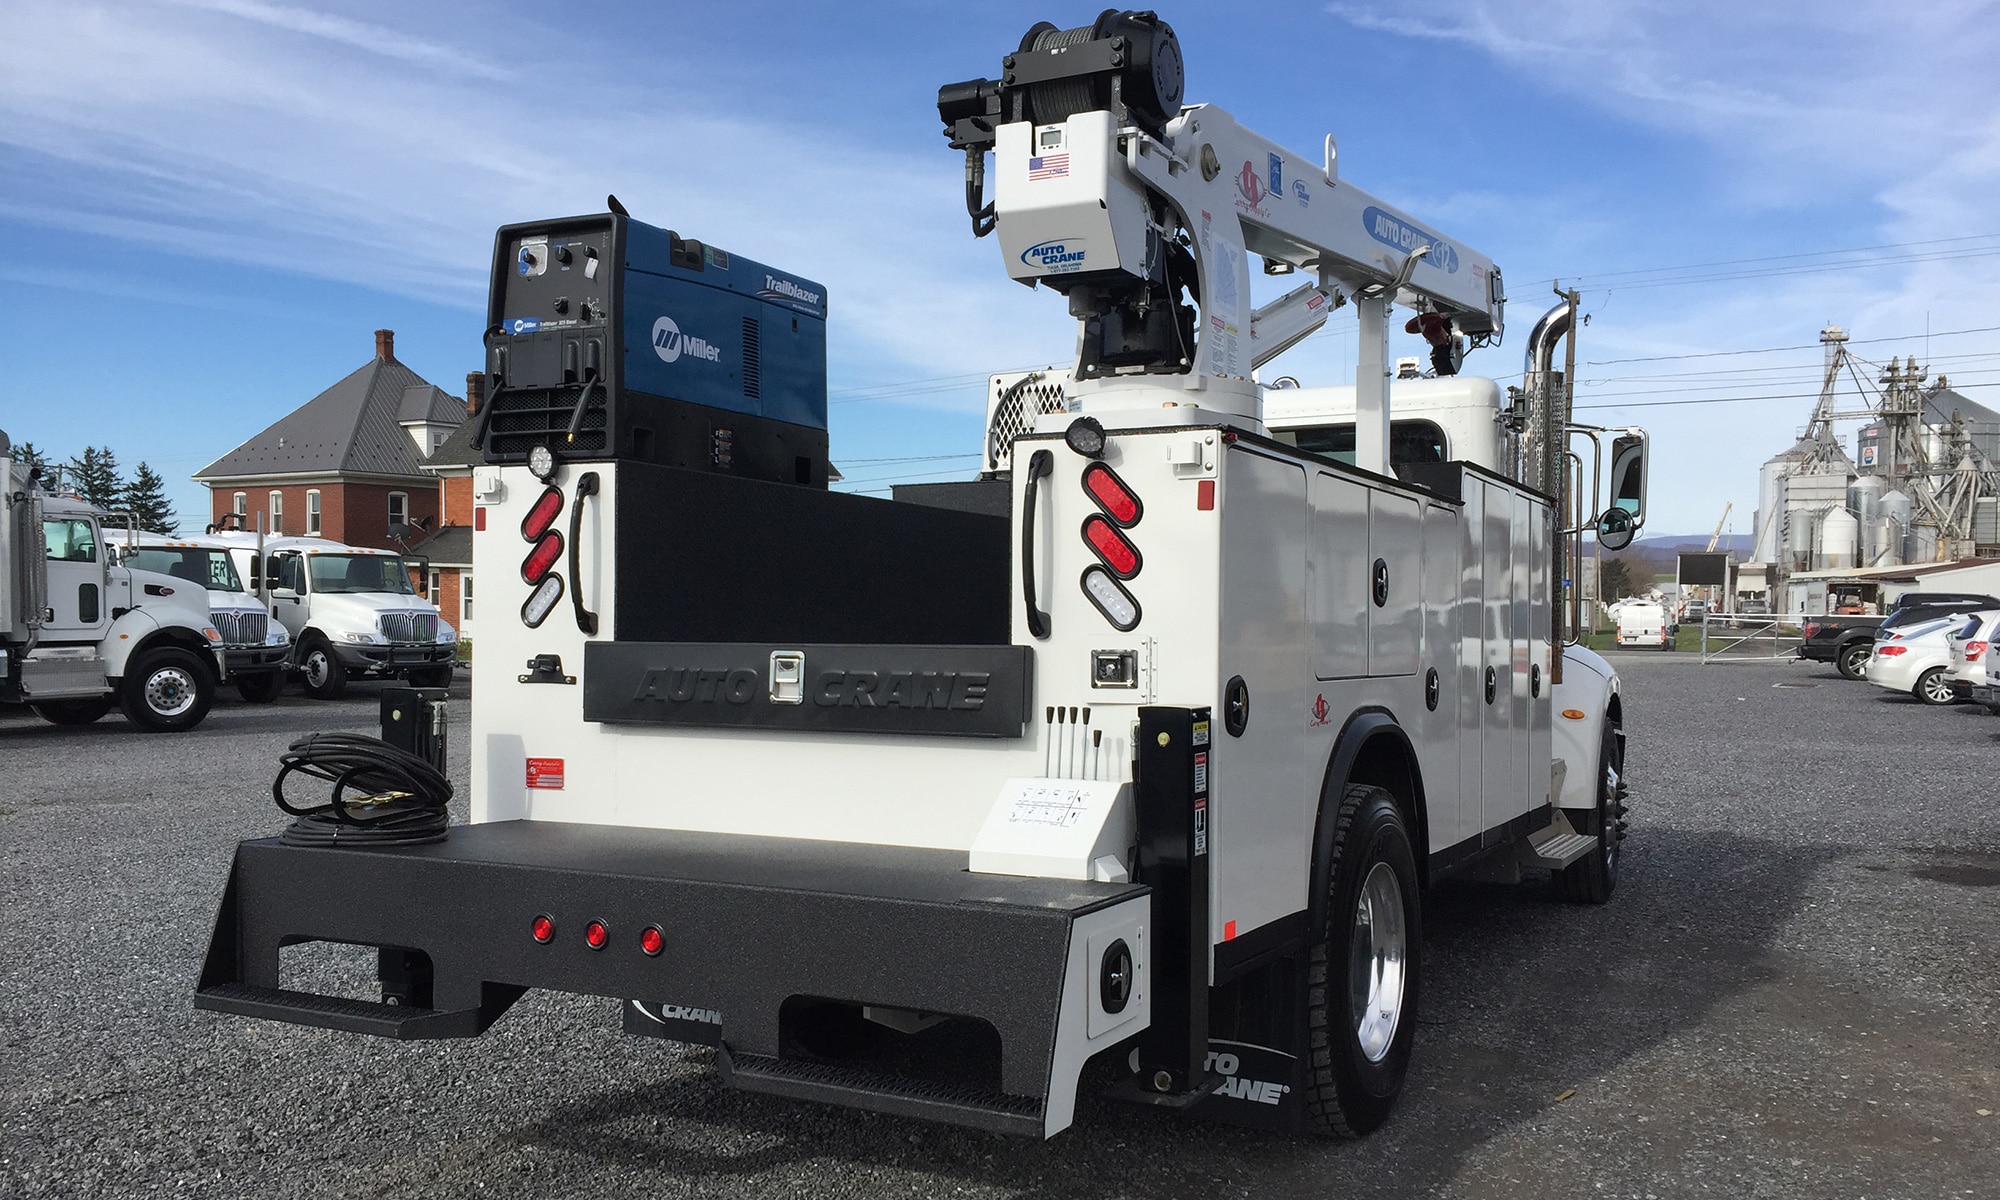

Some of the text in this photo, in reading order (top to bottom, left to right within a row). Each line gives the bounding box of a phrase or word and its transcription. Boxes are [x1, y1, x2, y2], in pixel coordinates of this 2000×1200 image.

[1375, 215, 1399, 244] AUTO
[1032, 245, 1065, 257] AUTO
[1042, 251, 1085, 265] CRANE
[765, 274, 820, 304] Trailblazer
[683, 334, 720, 363] Miller
[634, 667, 991, 711] AUTO CRANE
